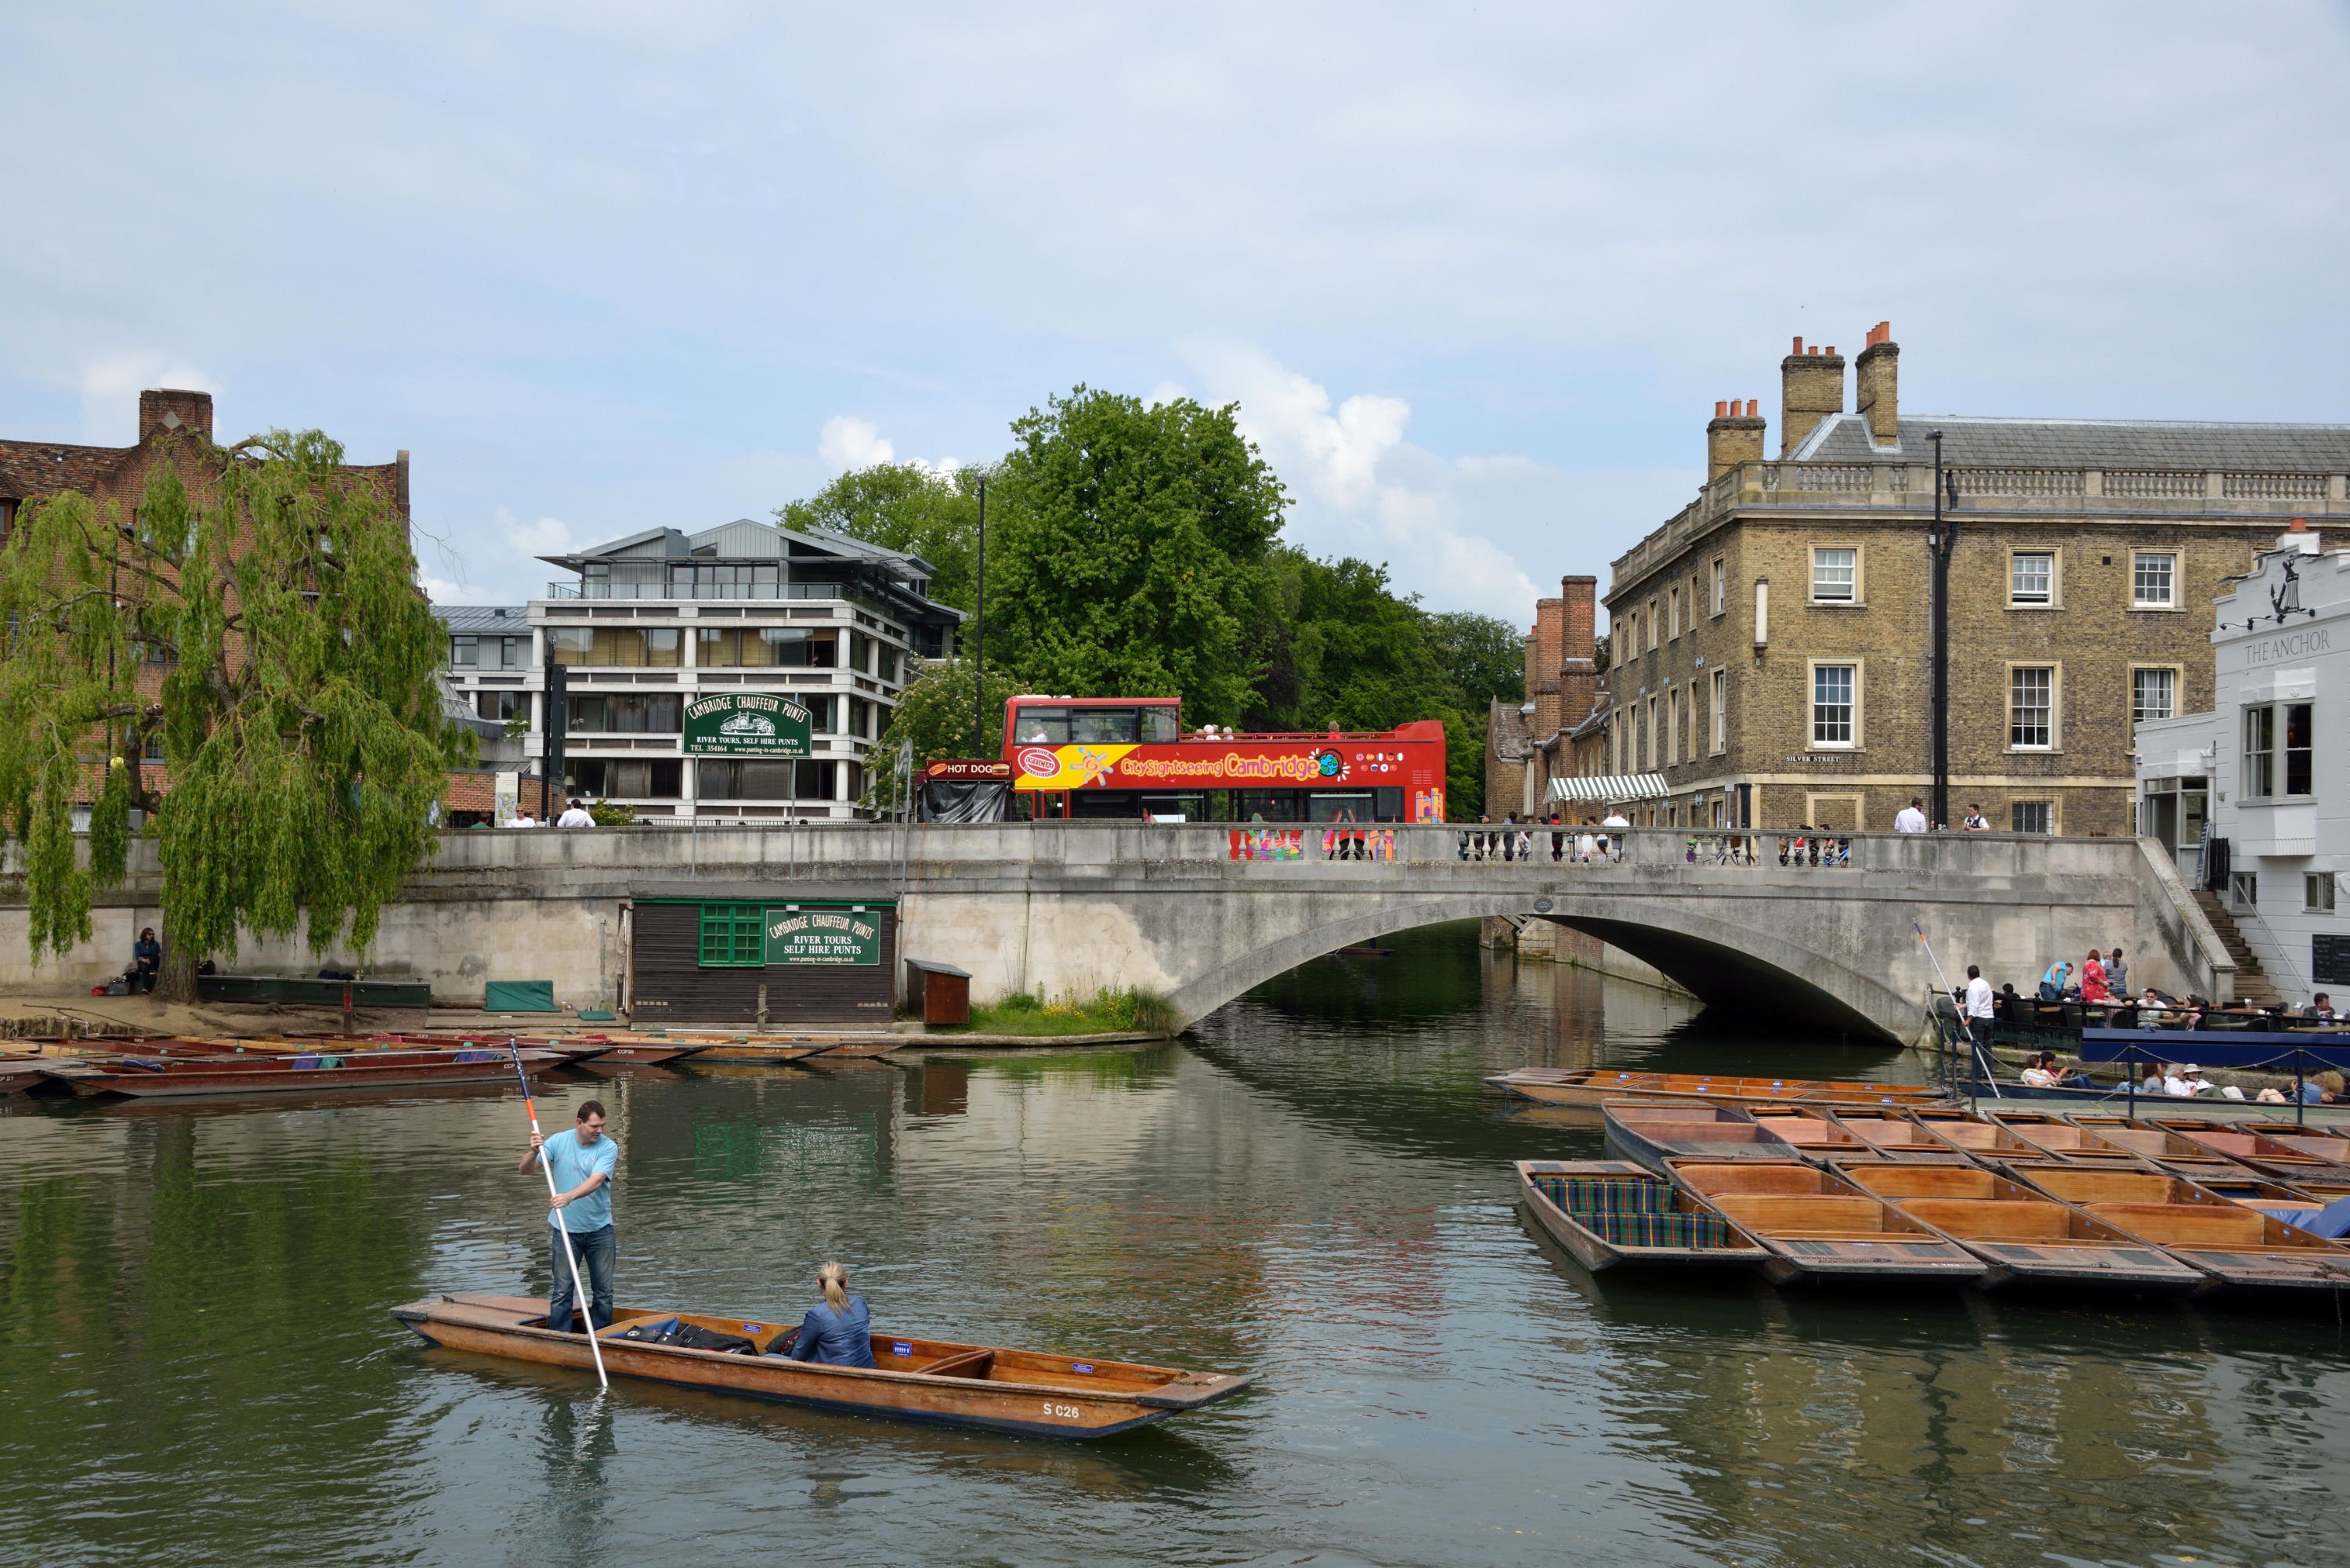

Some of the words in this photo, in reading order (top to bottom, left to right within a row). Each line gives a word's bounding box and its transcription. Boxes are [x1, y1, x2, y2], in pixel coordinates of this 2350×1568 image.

[2244, 642, 2269, 663] THE
[2271, 629, 2330, 659] ANCHOR
[688, 696, 732, 720] CAMBRIDGE
[736, 695, 778, 713] CHAUFFEUR
[782, 703, 808, 723] PUNTS
[734, 746, 804, 755] www.punting-in-cambridge.co.uk
[947, 764, 967, 773] HOT
[971, 764, 992, 773] DOG
[1026, 757, 1054, 769] OFFICIAL
[1121, 758, 1224, 777] CitySightseeing
[1224, 753, 1321, 781] Cambridge
[768, 916, 808, 939] CAMBRIDGE
[812, 914, 850, 930] CHAUFFEUR
[851, 920, 875, 940] PUNTS
[794, 935, 822, 945] RIVER
[823, 935, 852, 945] TOURS
[784, 945, 806, 954] SELF
[808, 945, 830, 954] HIRE
[833, 945, 862, 955] PUNTS
[1043, 1403, 1052, 1415] S
[1055, 1405, 1079, 1418] C26
